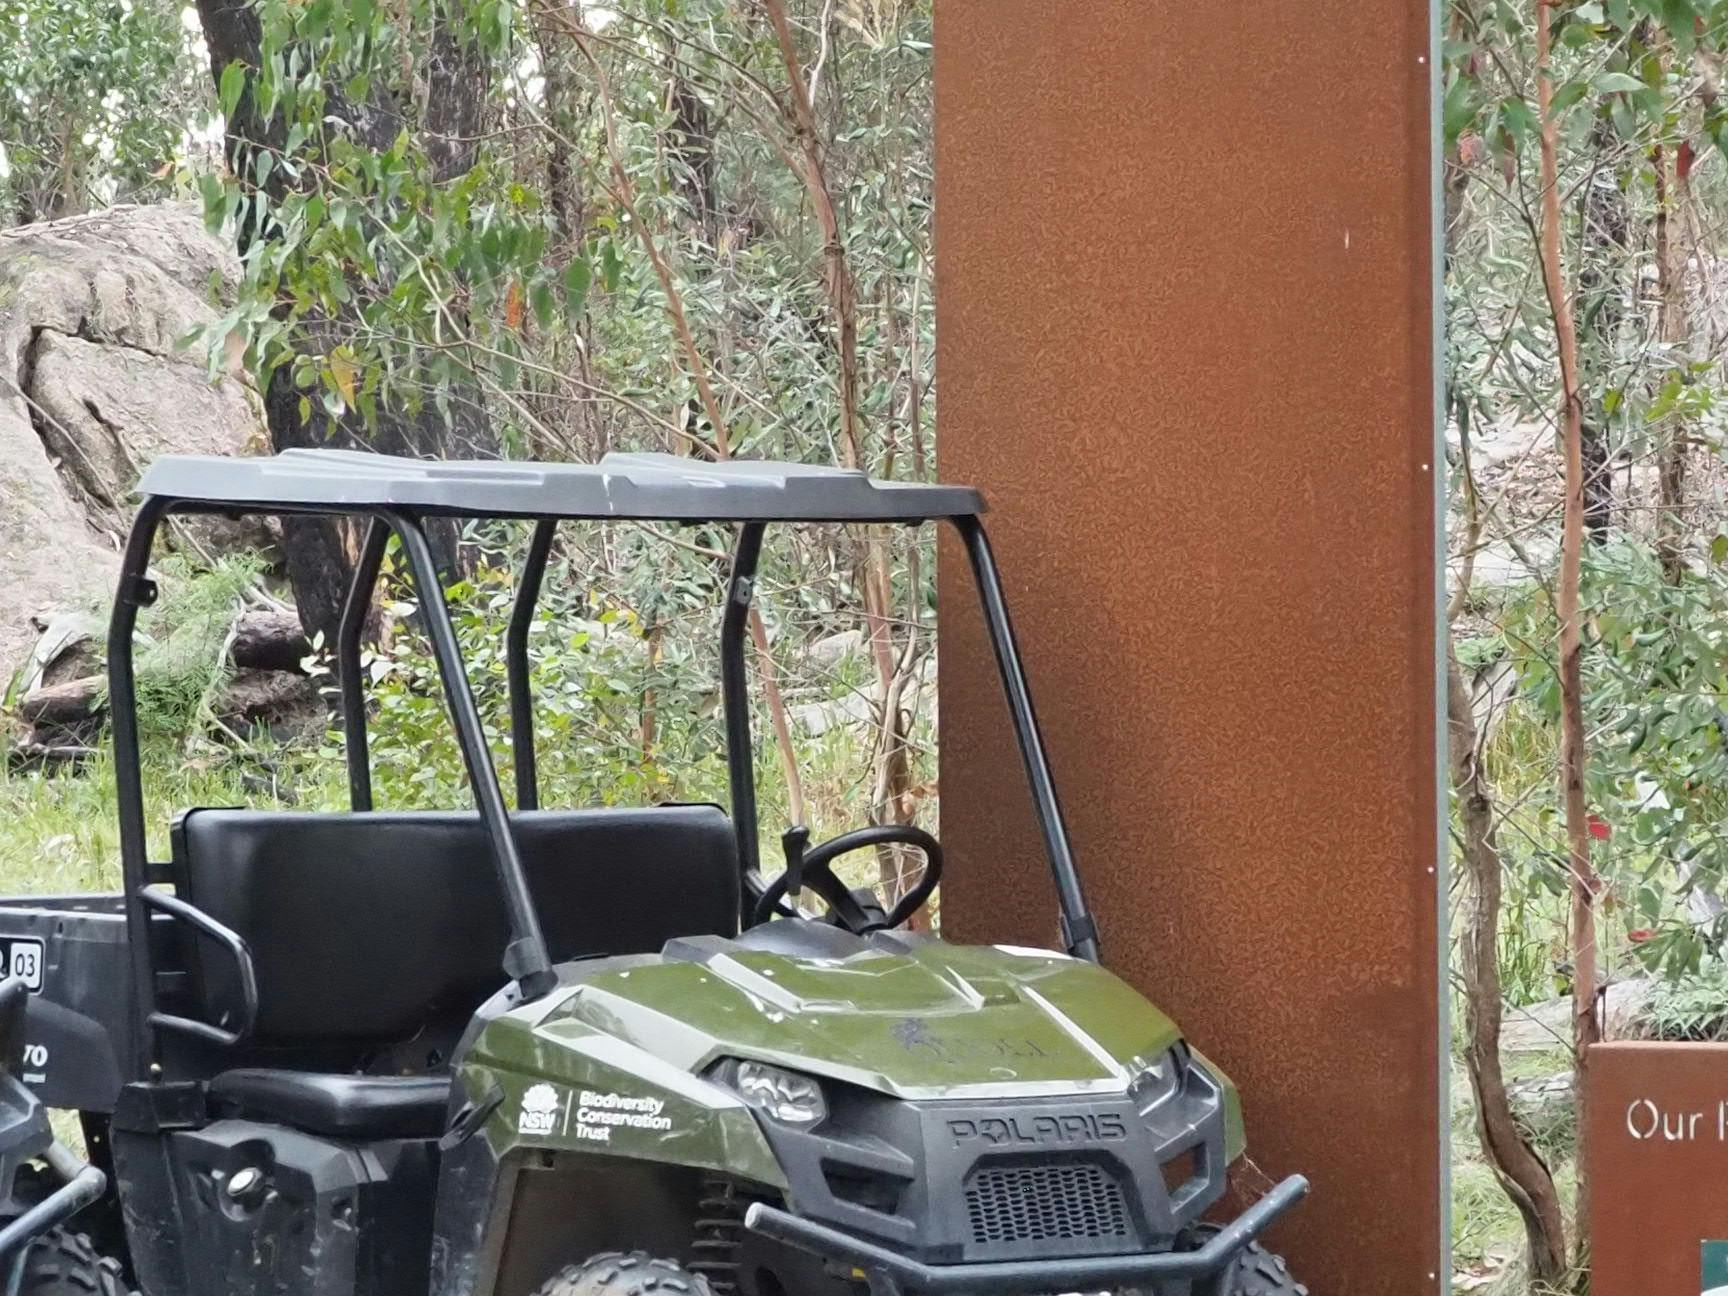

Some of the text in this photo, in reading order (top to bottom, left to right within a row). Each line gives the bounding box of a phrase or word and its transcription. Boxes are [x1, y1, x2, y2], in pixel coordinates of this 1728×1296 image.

[15, 954, 35, 977] 03
[579, 1090, 665, 1116] Biodiversity
[519, 1111, 556, 1129] NSW
[576, 1107, 672, 1130] Conservation
[1626, 1098, 1703, 1141] Our
[576, 1123, 610, 1141] Trust
[946, 1113, 1127, 1150] POLARIS
